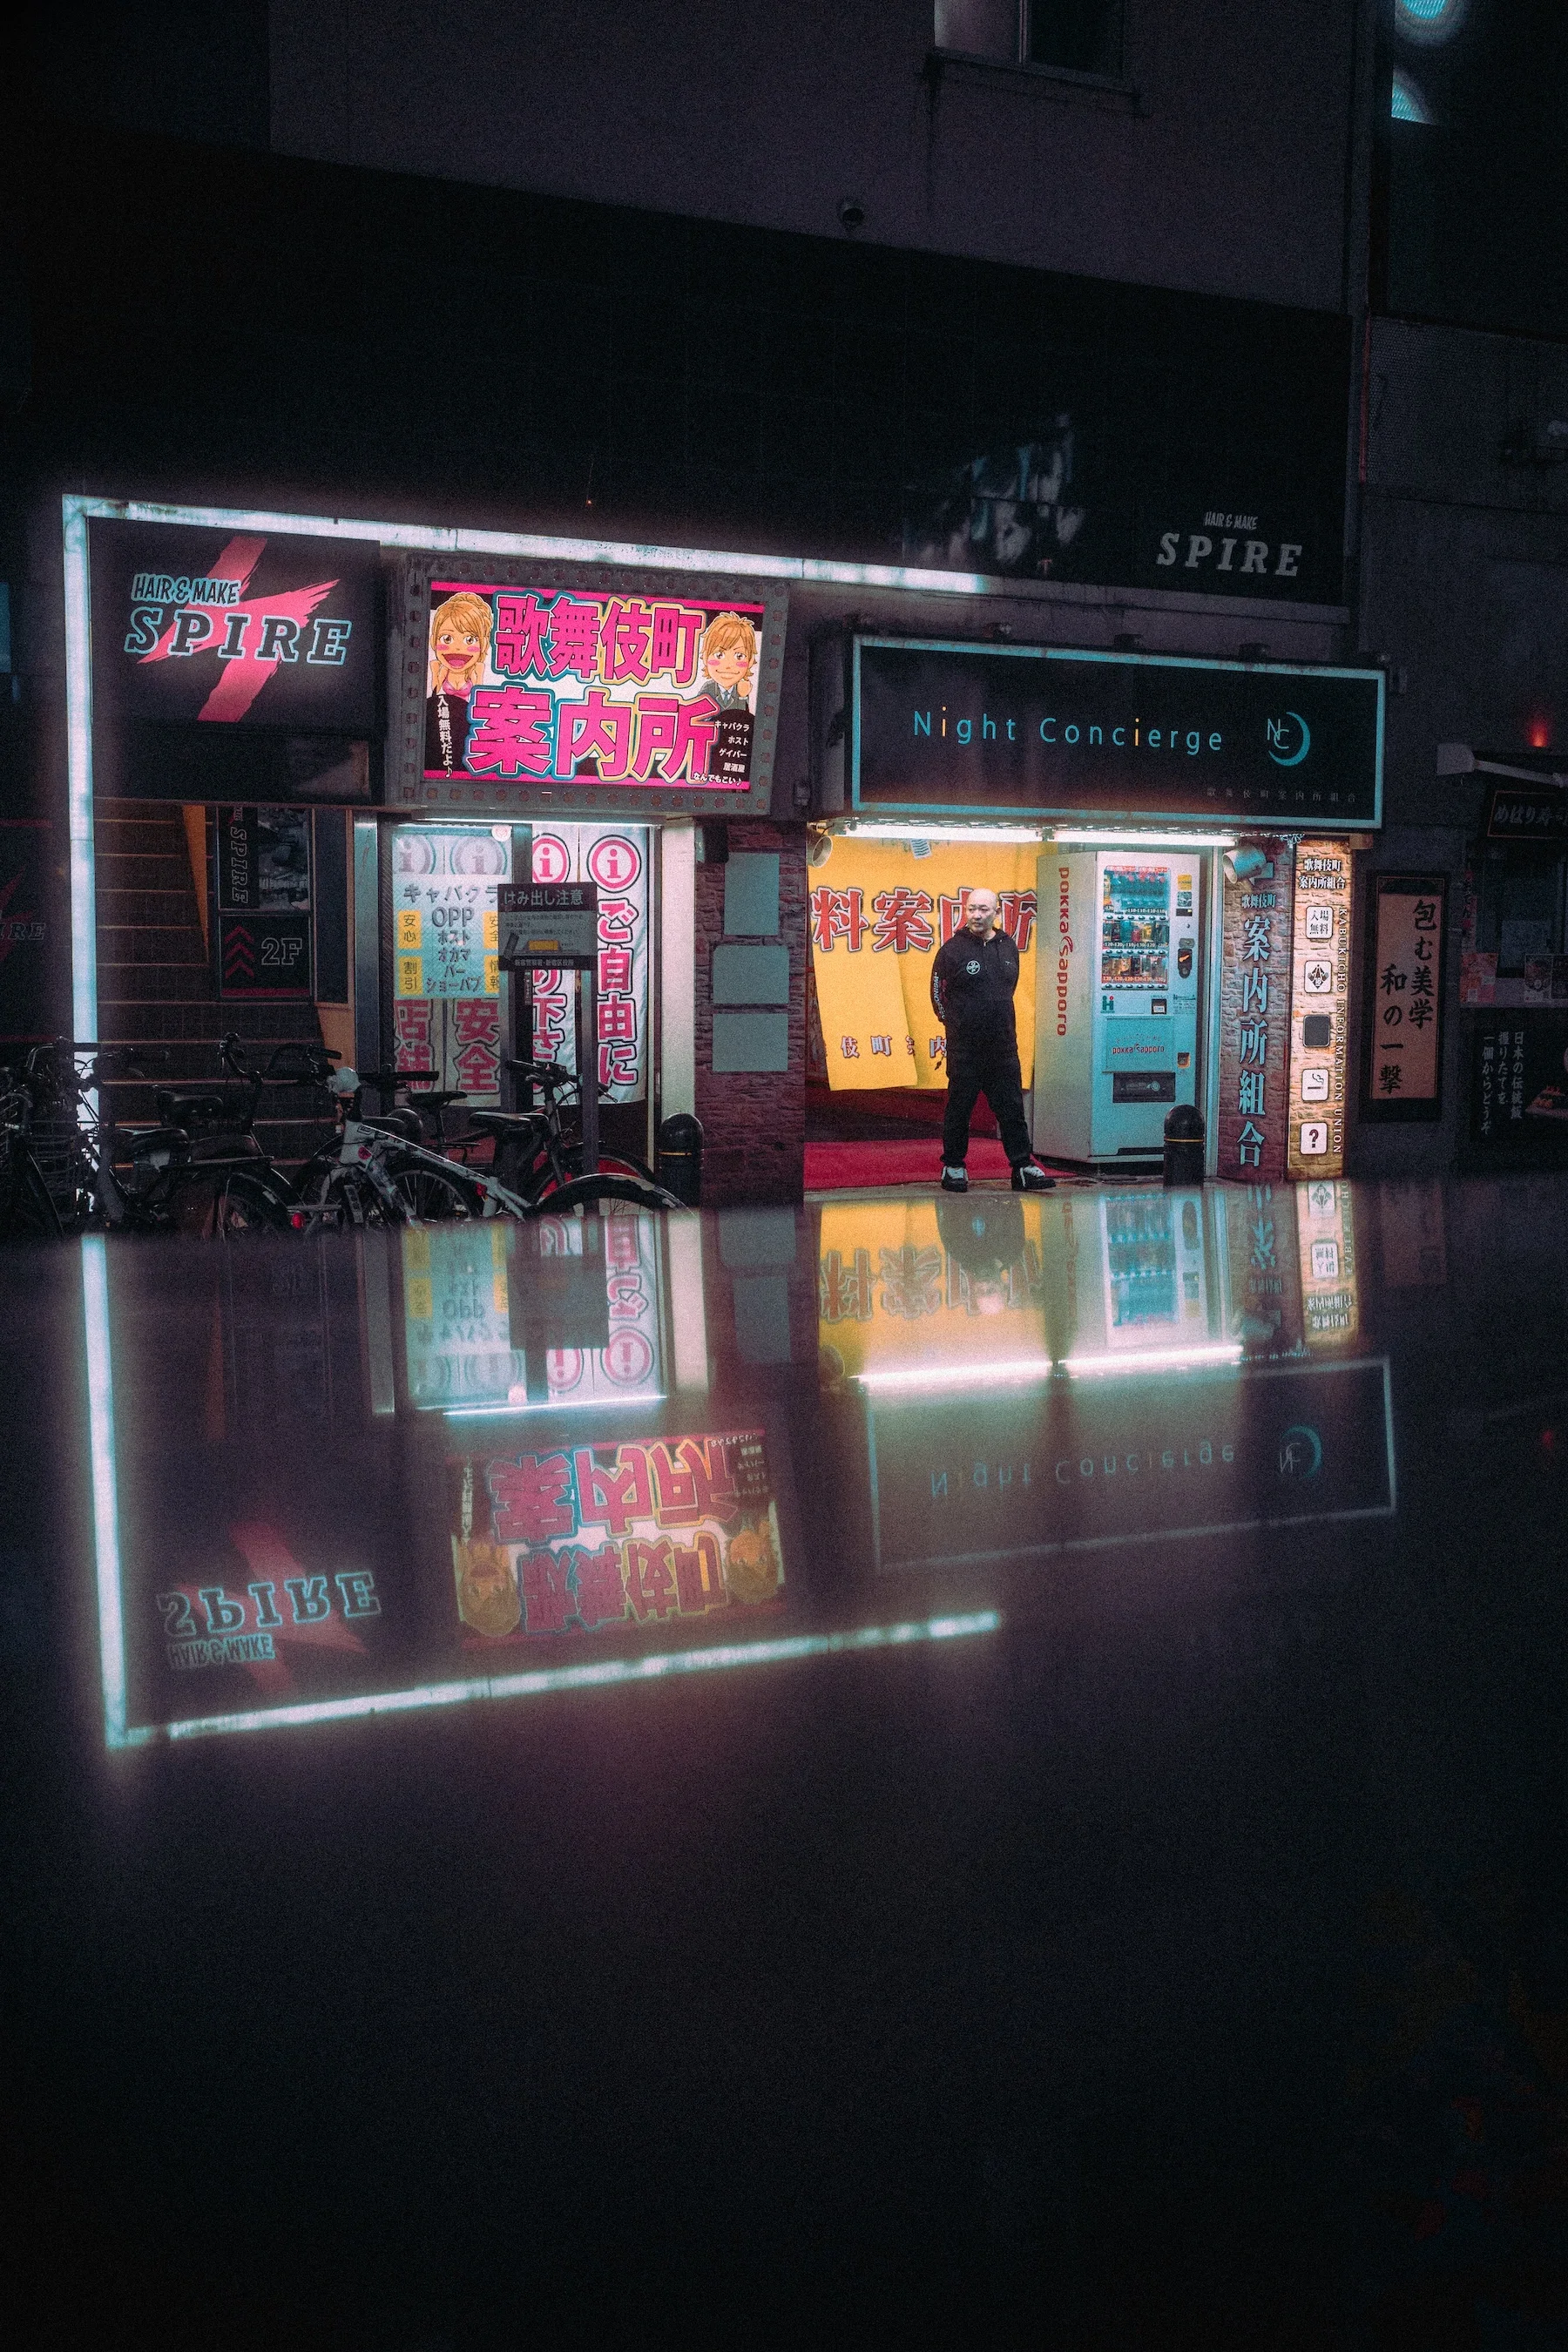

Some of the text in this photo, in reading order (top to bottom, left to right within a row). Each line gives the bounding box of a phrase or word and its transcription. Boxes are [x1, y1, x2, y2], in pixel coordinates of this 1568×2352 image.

[1156, 531, 1302, 577] SPIRE
[124, 607, 352, 666] SPIRE
[494, 592, 704, 686] 歌舞伎町
[467, 688, 721, 781] 案内所
[714, 720, 750, 733] キャバクラ
[914, 706, 1224, 755] Night Concierge
[719, 747, 747, 758] ゲイバー
[727, 736, 749, 747] ホスト
[723, 762, 746, 773] 居酒屋
[230, 827, 249, 904] SPIRE
[1304, 859, 1342, 872] 歌舞伎町
[1299, 875, 1346, 889] 案内所組合
[504, 889, 584, 907] はみ出し注意
[1241, 894, 1276, 909] 歌舞伎町
[403, 915, 417, 942] 安心
[431, 907, 475, 928] OPP
[260, 937, 303, 966] 2F
[437, 929, 471, 946] ホスト
[438, 947, 471, 963] オカマ
[1408, 899, 1437, 1030] 包む美学
[403, 962, 417, 990] 割引
[598, 900, 637, 1086] ご自由に
[1236, 915, 1272, 1168] 案内所組合
[1333, 908, 1348, 1153] KABUKICHO INFORMATION UNION
[1379, 963, 1408, 1095] 和の一撃
